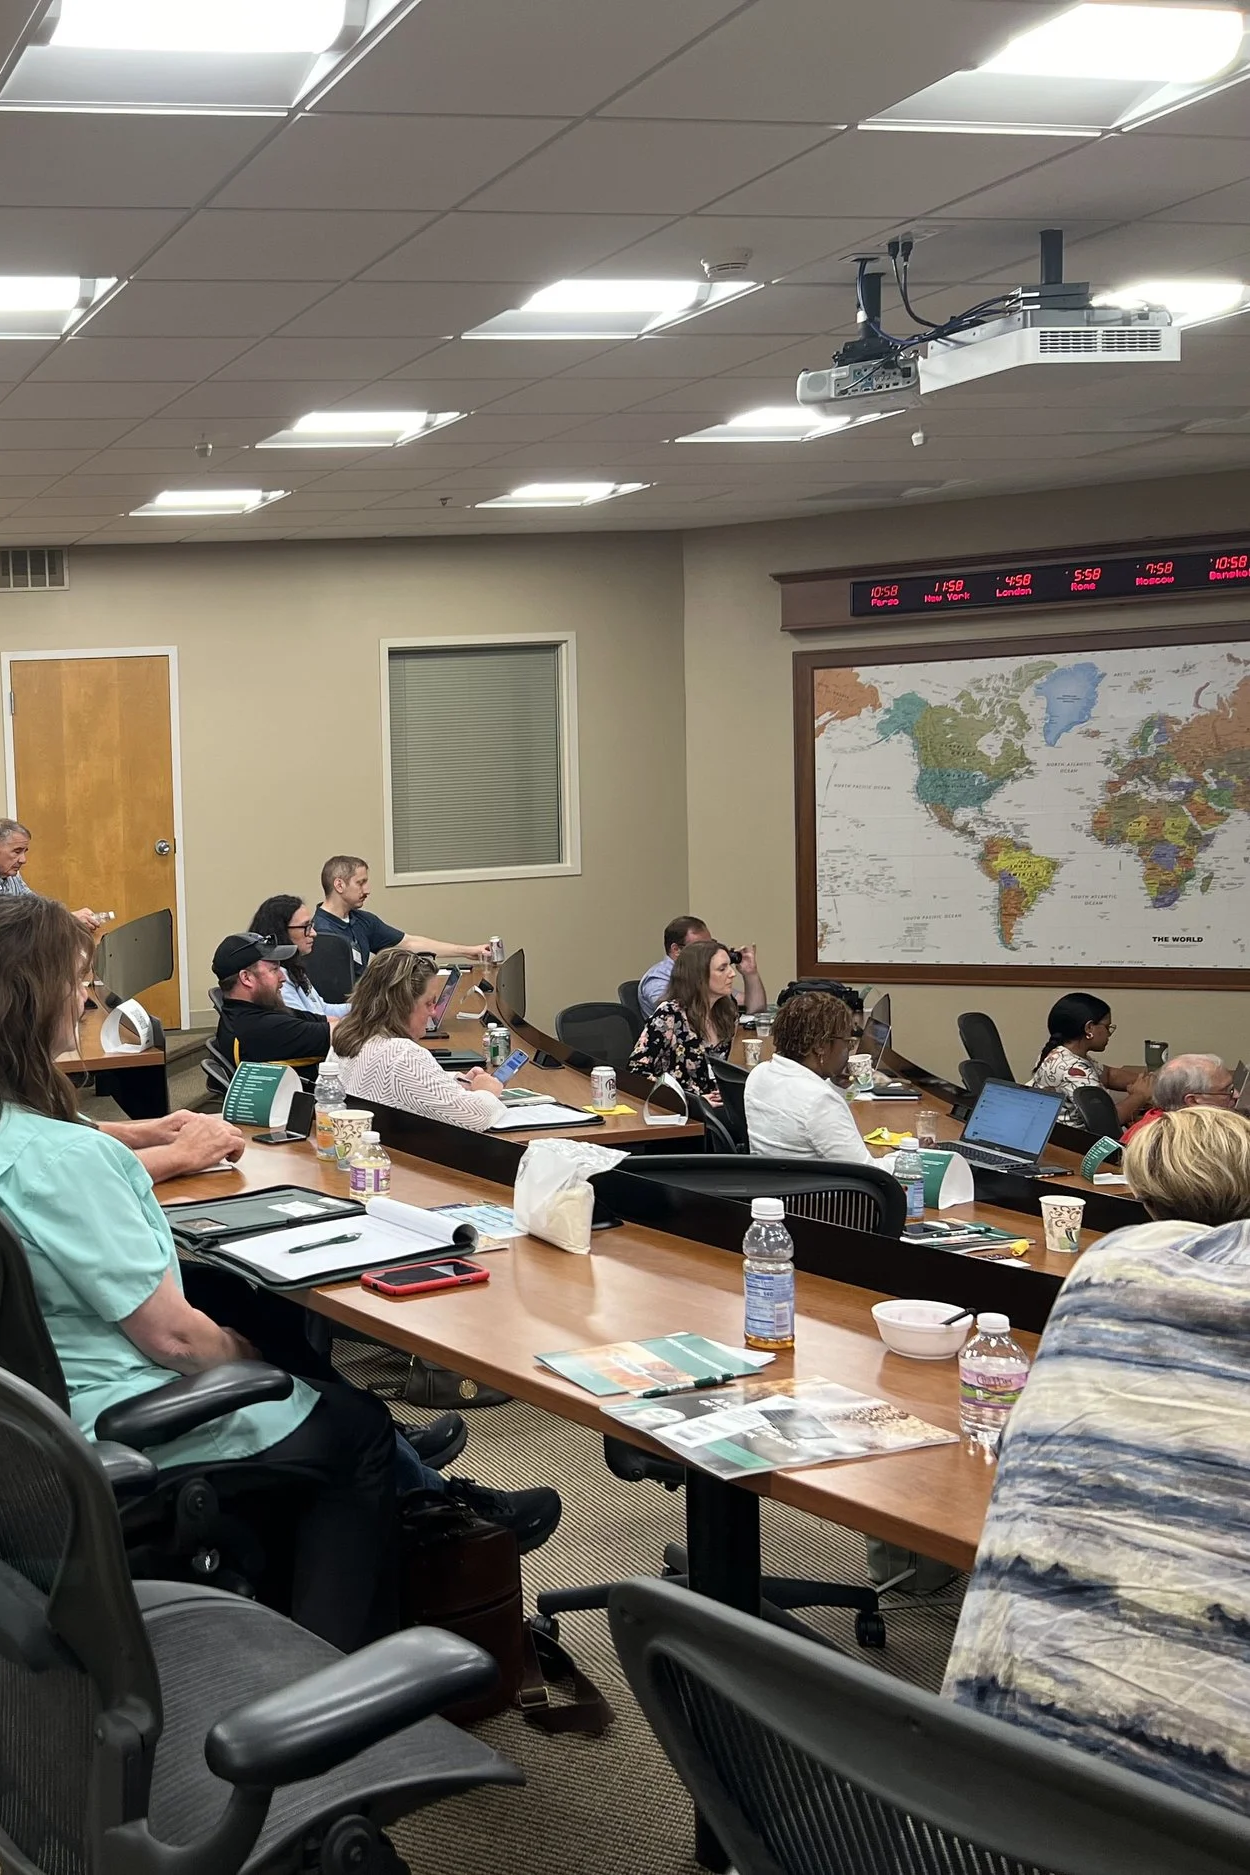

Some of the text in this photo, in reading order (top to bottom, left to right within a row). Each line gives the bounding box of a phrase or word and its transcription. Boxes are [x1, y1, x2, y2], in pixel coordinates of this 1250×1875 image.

[1145, 561, 1174, 575] 7:58
[1214, 555, 1248, 569] 10:58
[1005, 573, 1032, 586] 4:58
[1073, 567, 1102, 581] 5:58
[934, 580, 964, 592] 11:58
[1070, 582, 1096, 591] Rome
[1135, 576, 1175, 586] Moscow
[870, 585, 899, 598] 10:58
[924, 591, 971, 603] New York
[995, 587, 1032, 597] London
[870, 598, 900, 607] Fargo
